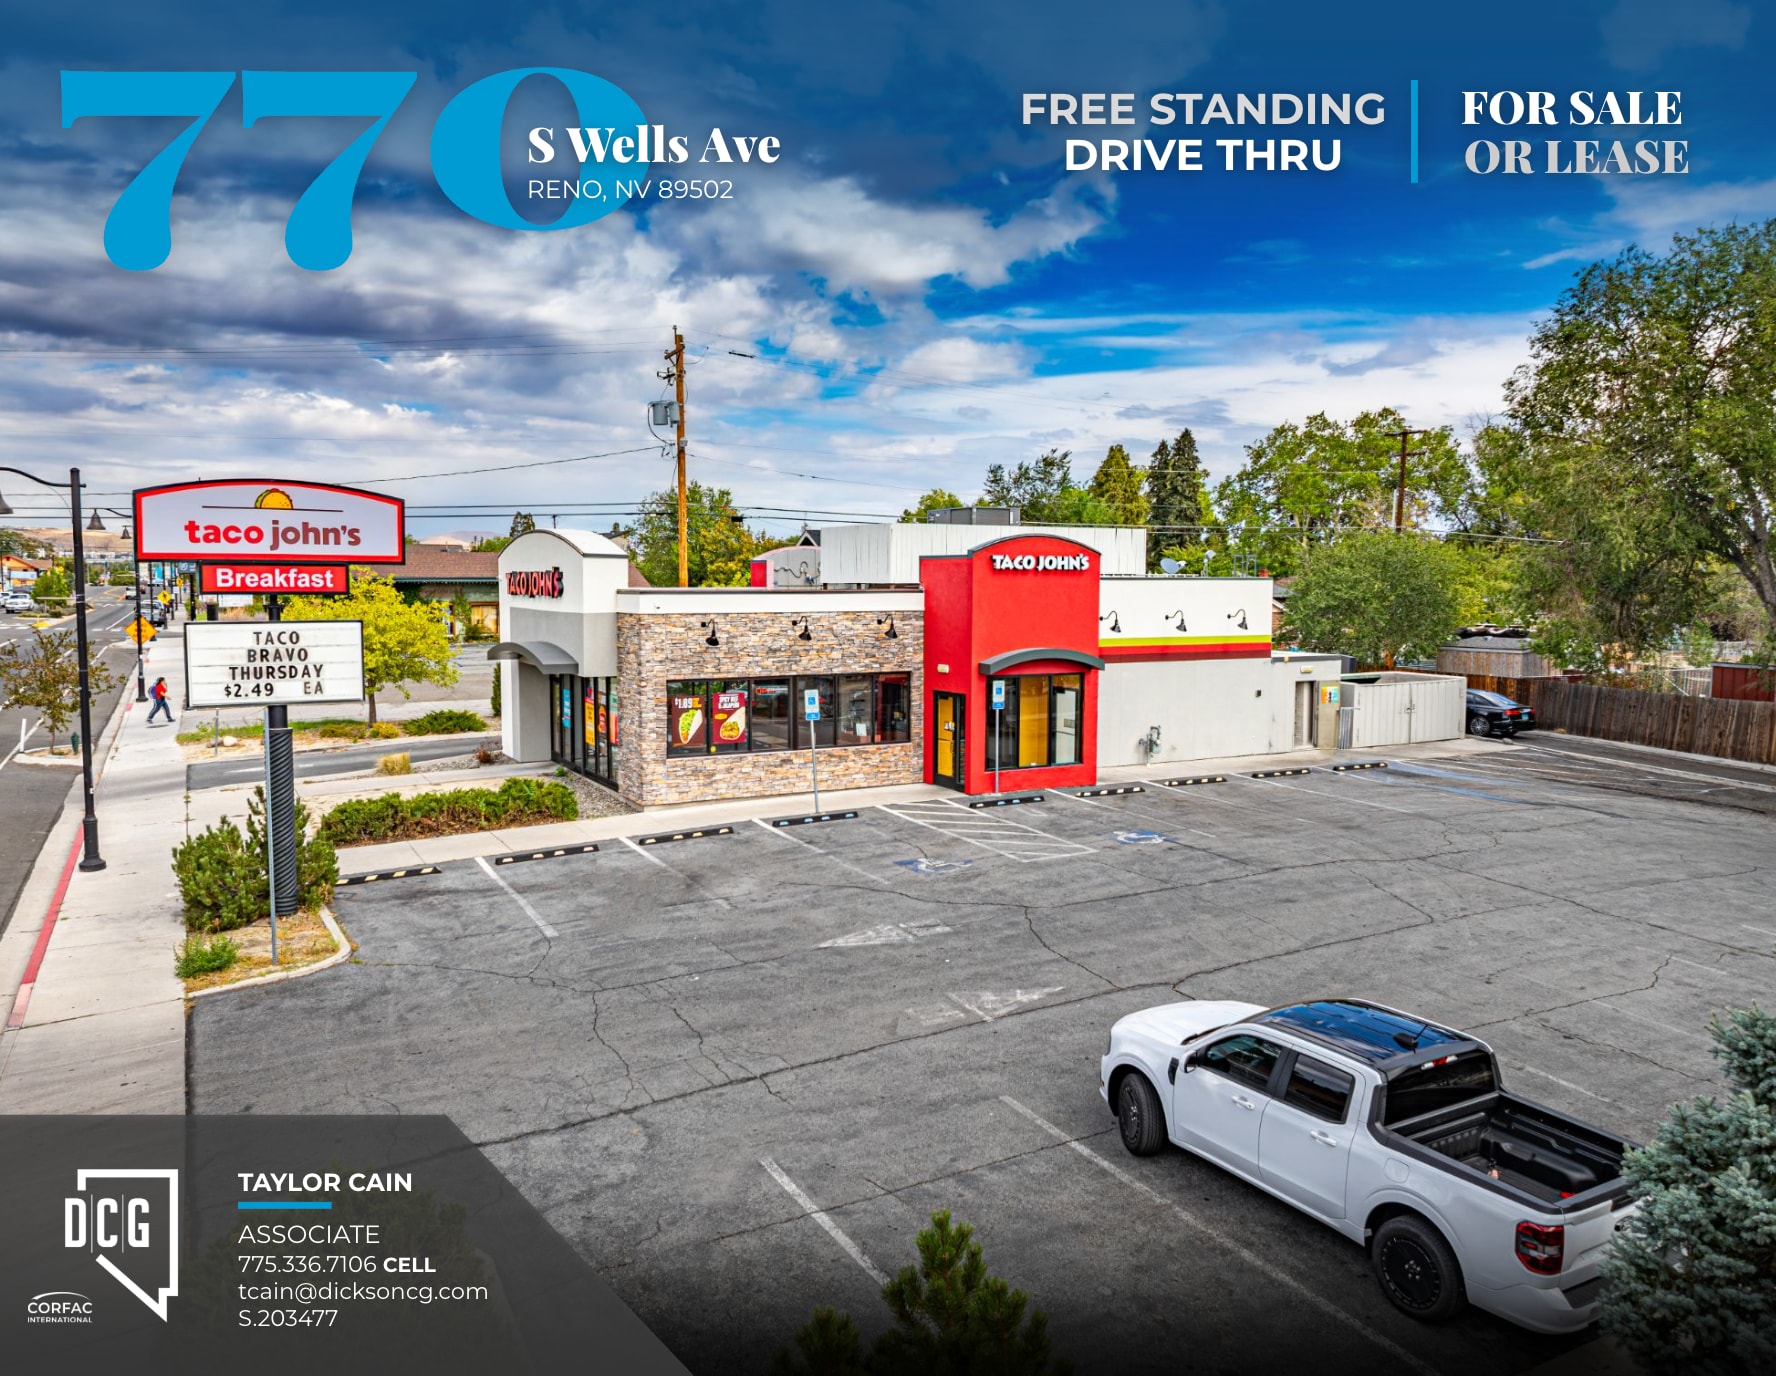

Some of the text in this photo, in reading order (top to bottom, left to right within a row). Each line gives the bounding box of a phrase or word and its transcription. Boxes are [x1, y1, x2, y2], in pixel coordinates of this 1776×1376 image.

[184, 520, 362, 551] taco john's
[991, 552, 1091, 572] TACO JOHN'S
[215, 568, 335, 588] Breakfast
[252, 631, 301, 646] TACO
[247, 648, 309, 663] BRAVO
[229, 664, 325, 681] THURSDAY
[224, 681, 325, 698] $2.49 EA
